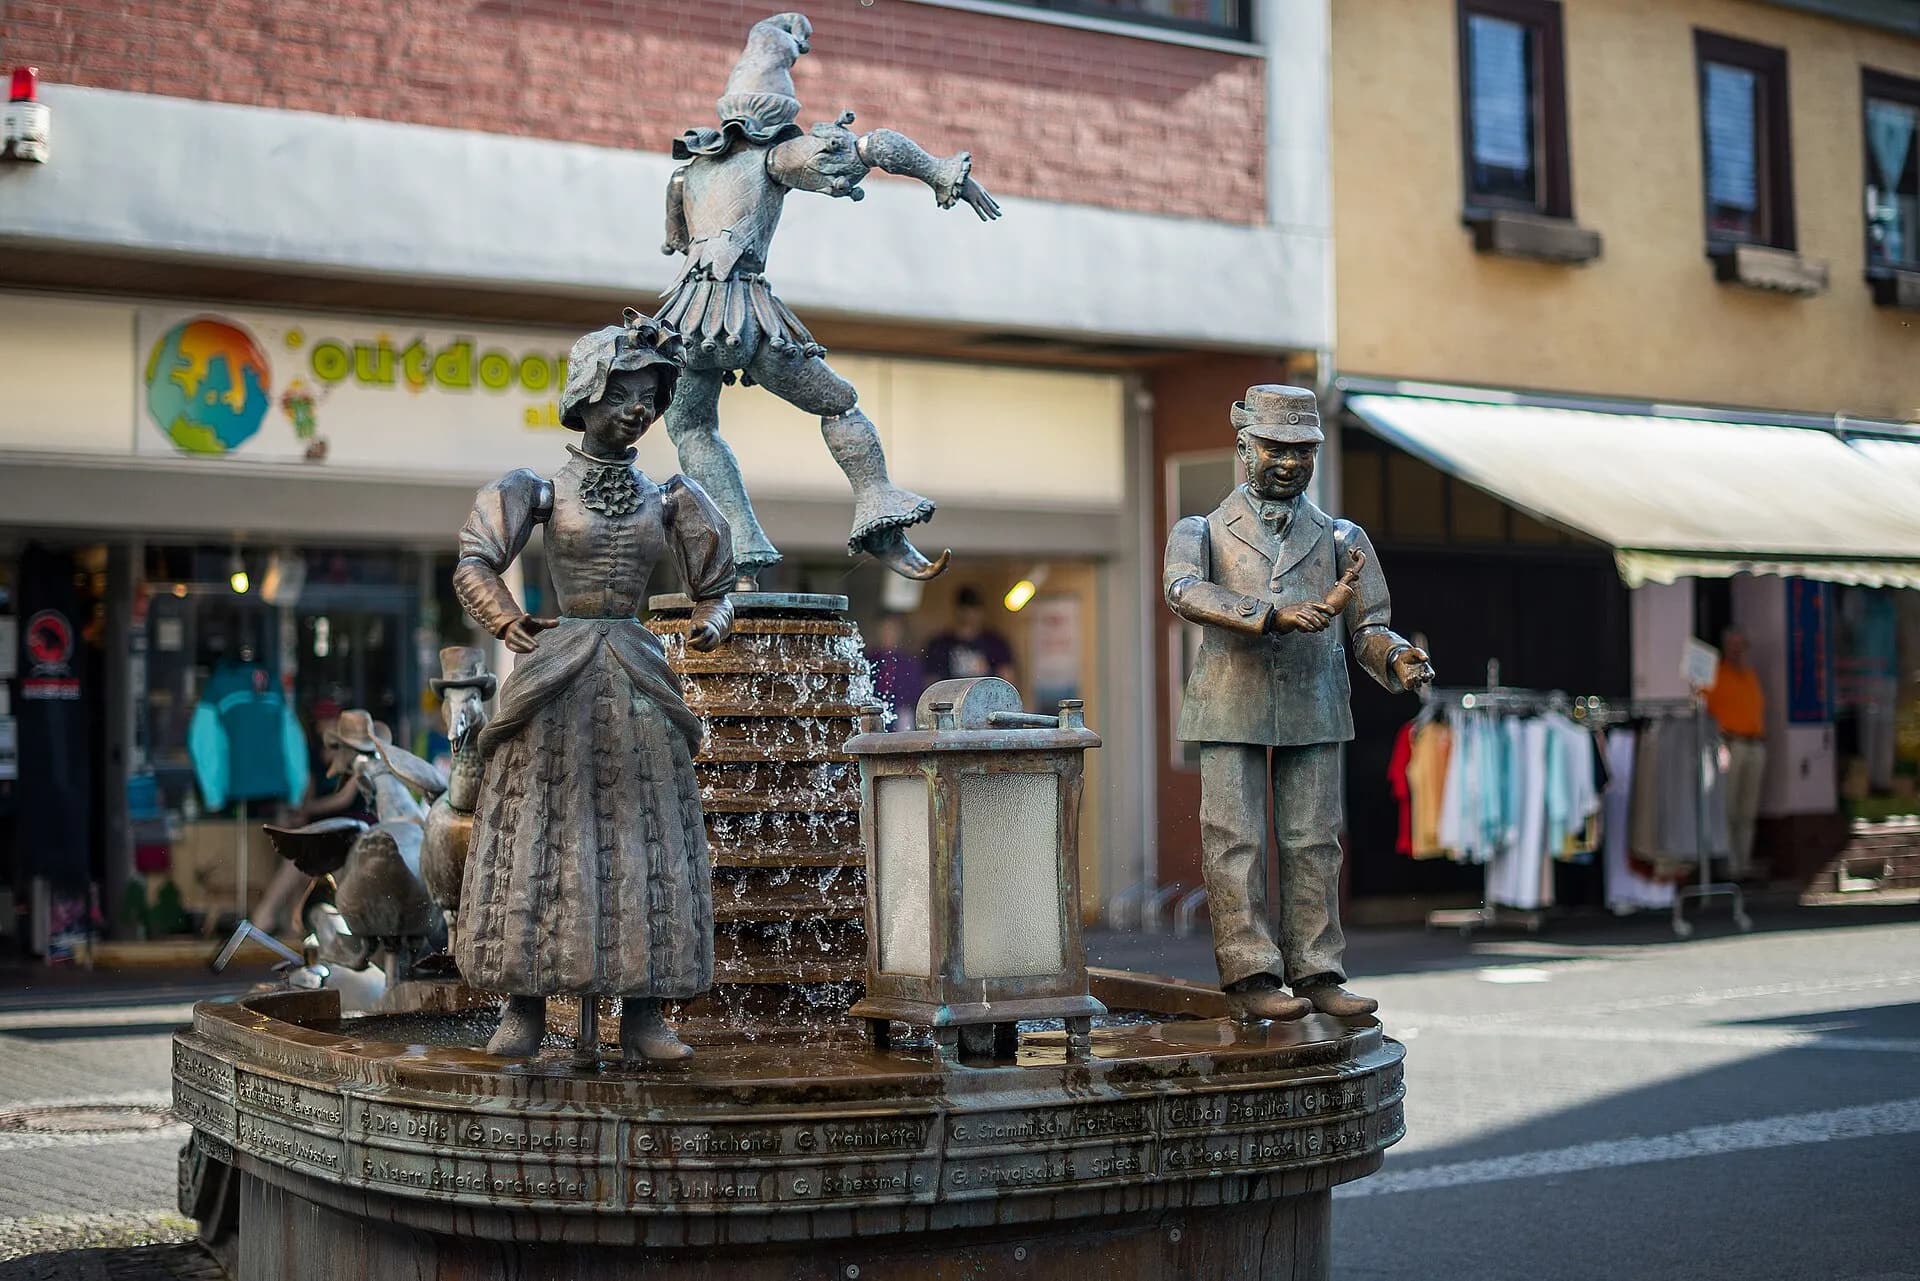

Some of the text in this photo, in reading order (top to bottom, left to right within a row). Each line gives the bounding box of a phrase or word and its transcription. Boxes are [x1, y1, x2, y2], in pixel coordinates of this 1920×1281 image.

[1193, 1107, 1222, 1121] Don
[376, 1114, 399, 1133] Die
[406, 1119, 447, 1139] Delis
[952, 1126, 971, 1140] G.
[467, 1123, 591, 1150] G. Deppchen
[638, 1133, 658, 1151] G.
[798, 1131, 817, 1147] G.
[793, 1176, 812, 1194] G.
[951, 1168, 969, 1186] G.
[635, 1181, 659, 1198] G.
